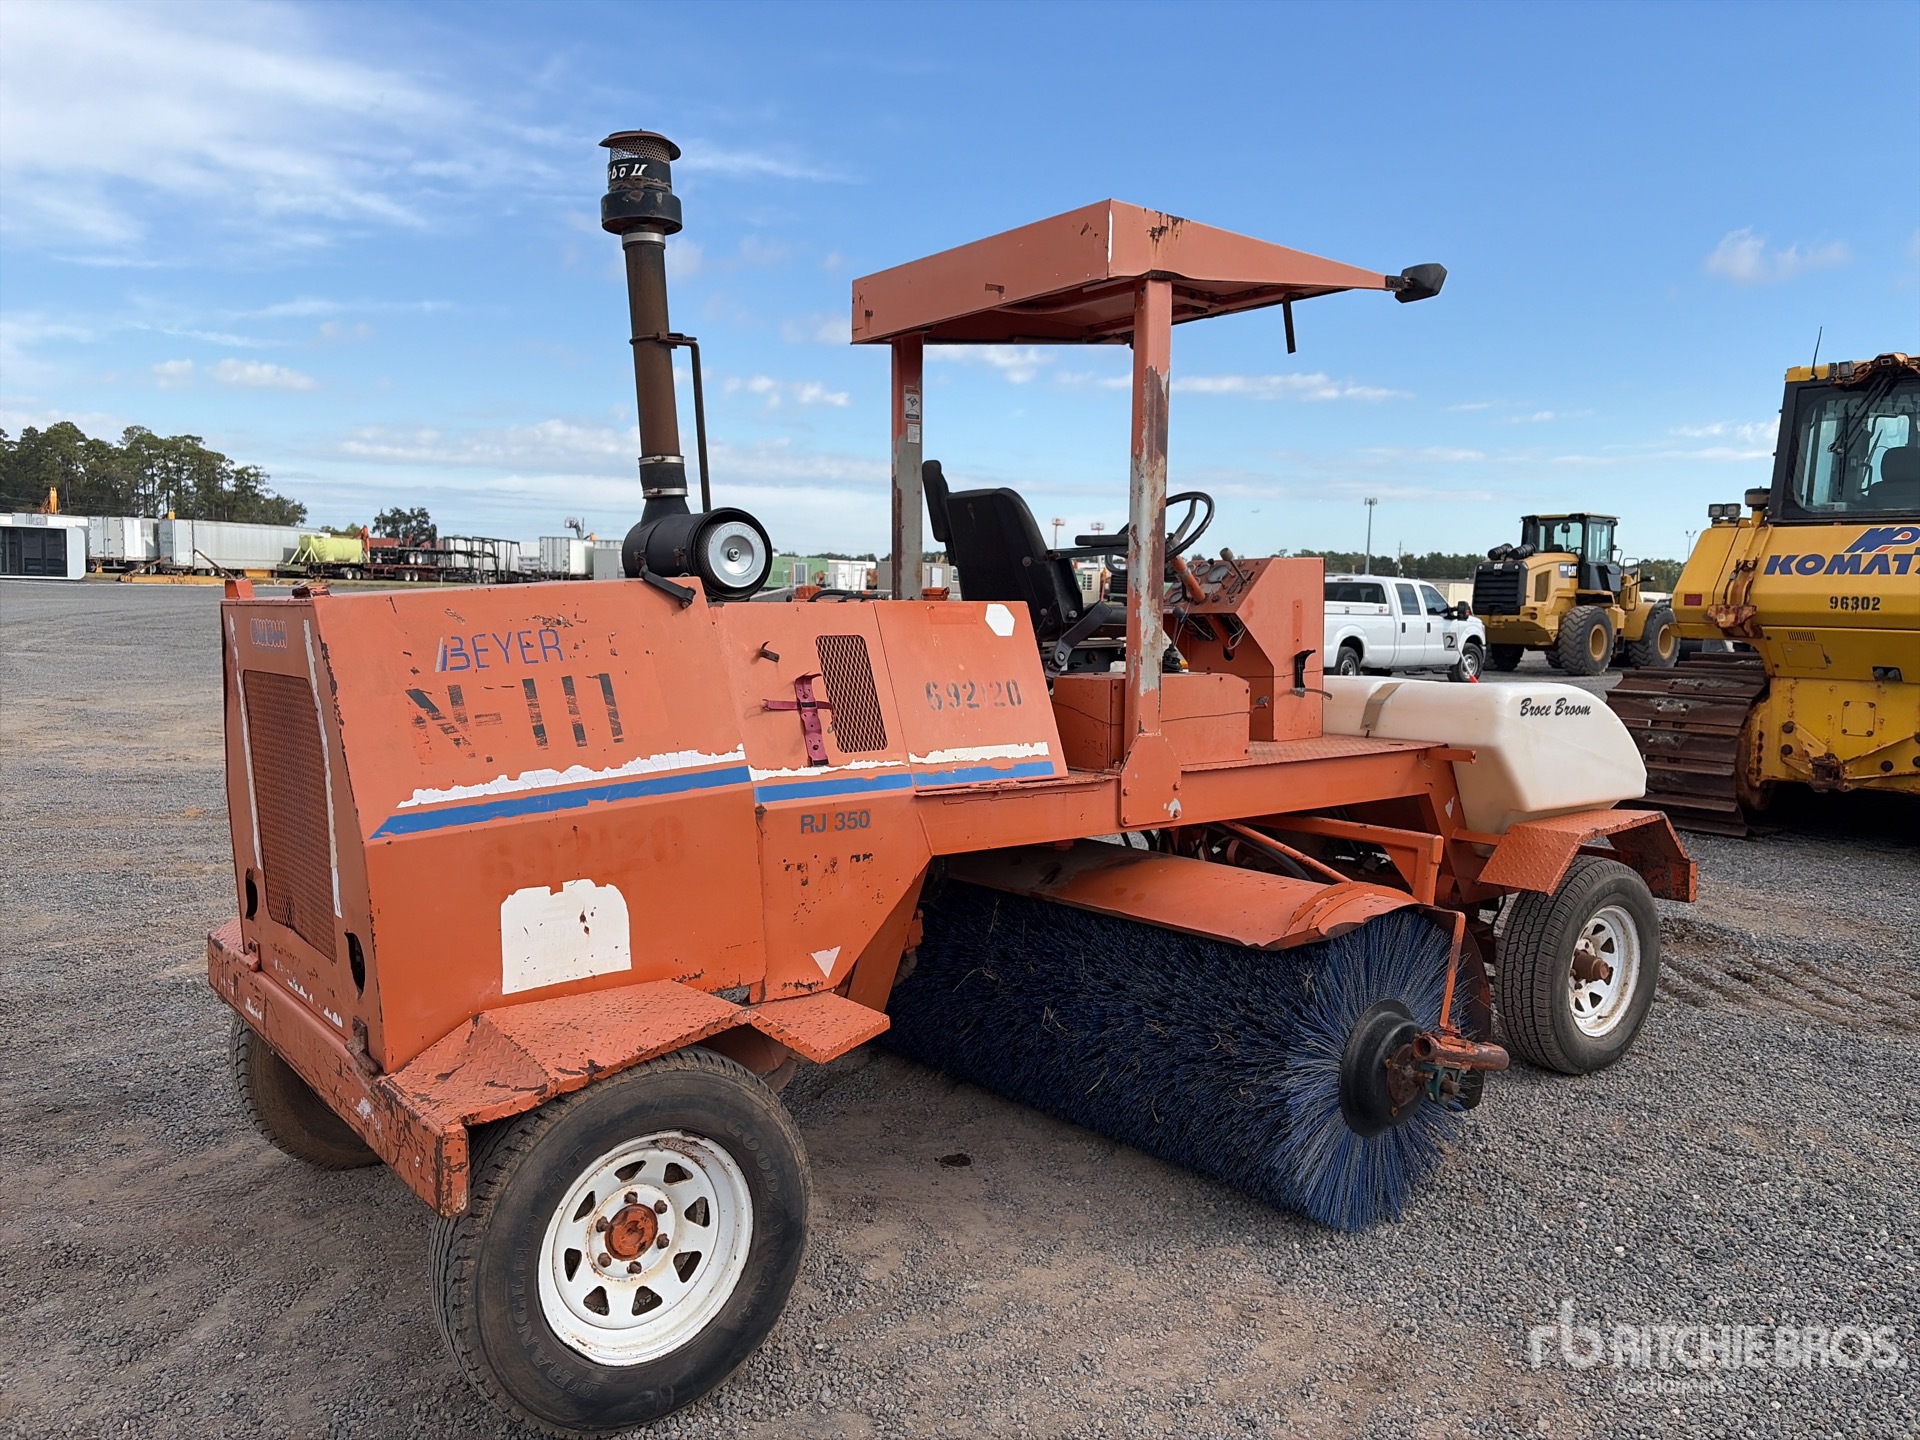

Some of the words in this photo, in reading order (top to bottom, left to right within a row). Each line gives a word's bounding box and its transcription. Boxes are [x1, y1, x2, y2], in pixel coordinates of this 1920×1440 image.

[1829, 596, 1881, 612] 96302
[435, 628, 564, 673] BEYER
[1445, 635, 1456, 649] 2
[1519, 697, 1552, 717] Broce
[1554, 697, 1592, 716] Broom
[801, 813, 827, 835] RJ
[834, 809, 871, 832] 350
